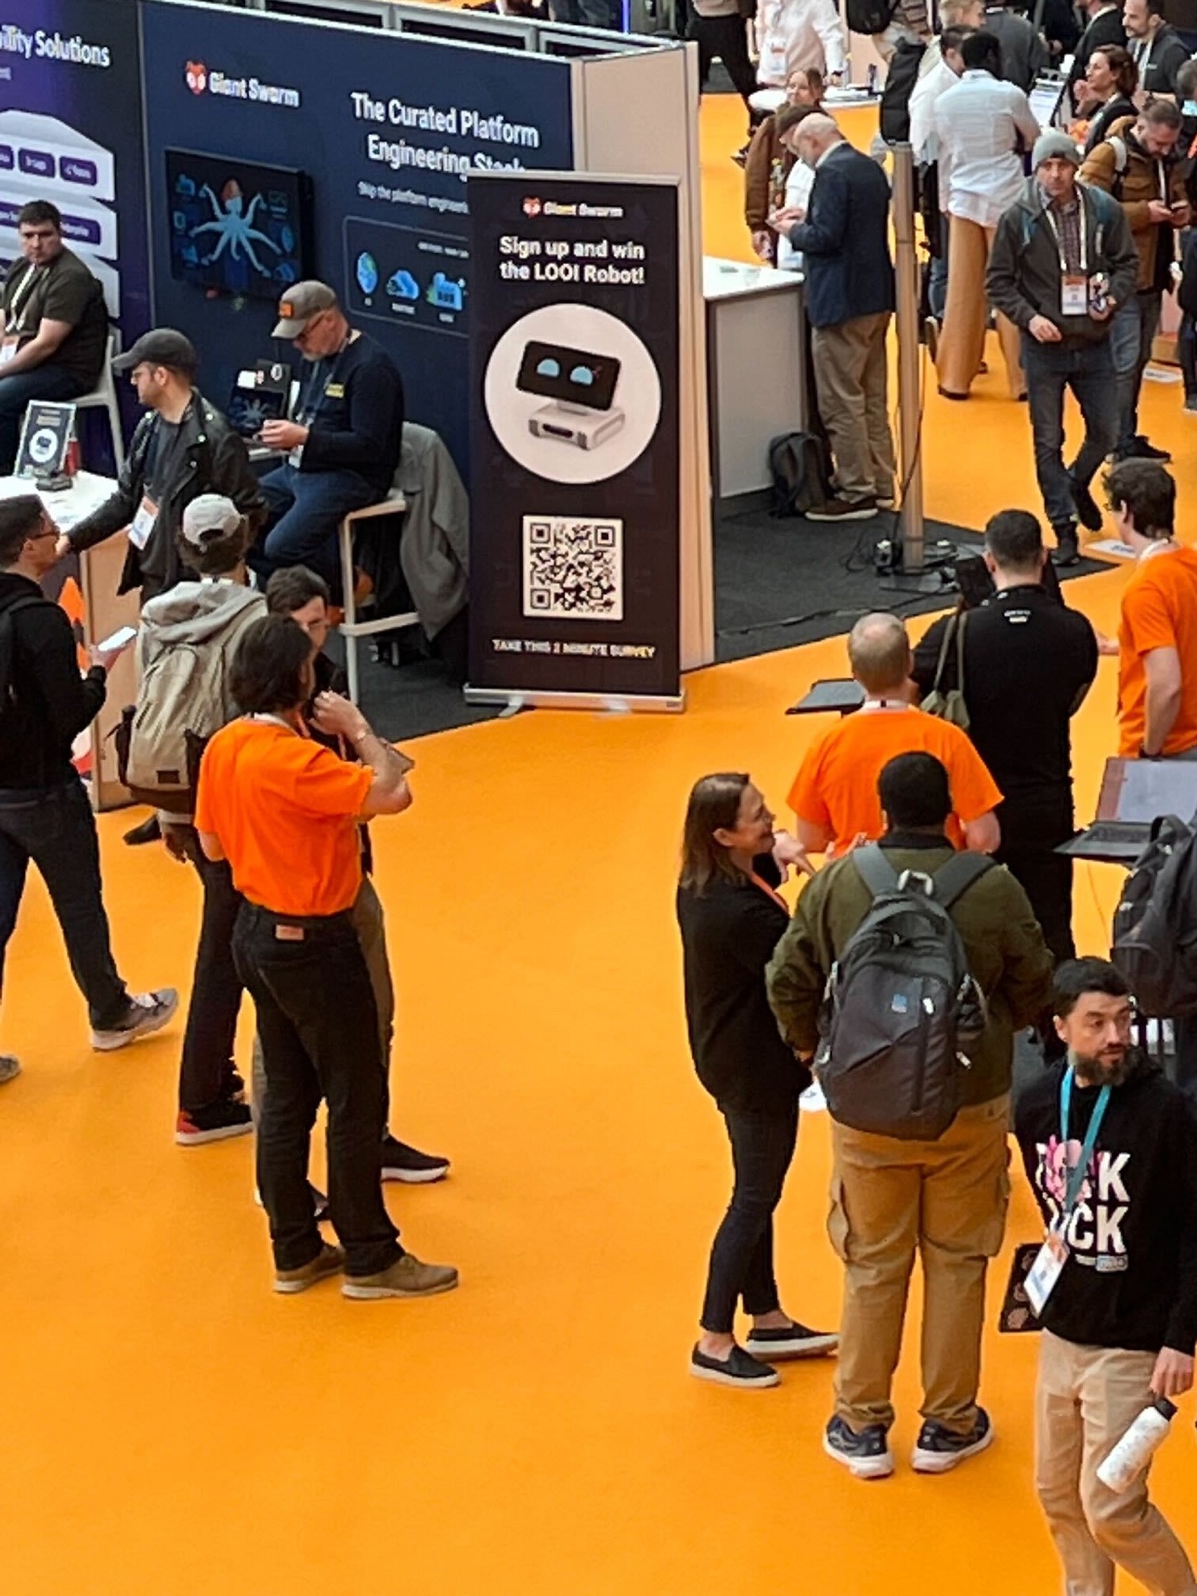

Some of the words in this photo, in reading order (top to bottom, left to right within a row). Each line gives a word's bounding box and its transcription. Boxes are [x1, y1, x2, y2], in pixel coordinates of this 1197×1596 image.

[35, 30, 111, 67] Solutions
[209, 71, 247, 99] Giant
[248, 77, 299, 107] Swarm
[351, 92, 385, 122] The
[388, 98, 457, 134] Curated
[460, 110, 540, 148] Platform
[367, 133, 470, 183] Engineering
[500, 236, 541, 258] Sign
[545, 241, 570, 260] up
[573, 239, 608, 259] and
[611, 241, 645, 259] win
[500, 260, 530, 280] the
[534, 263, 580, 281] LOOI
[584, 265, 645, 284] Robot!
